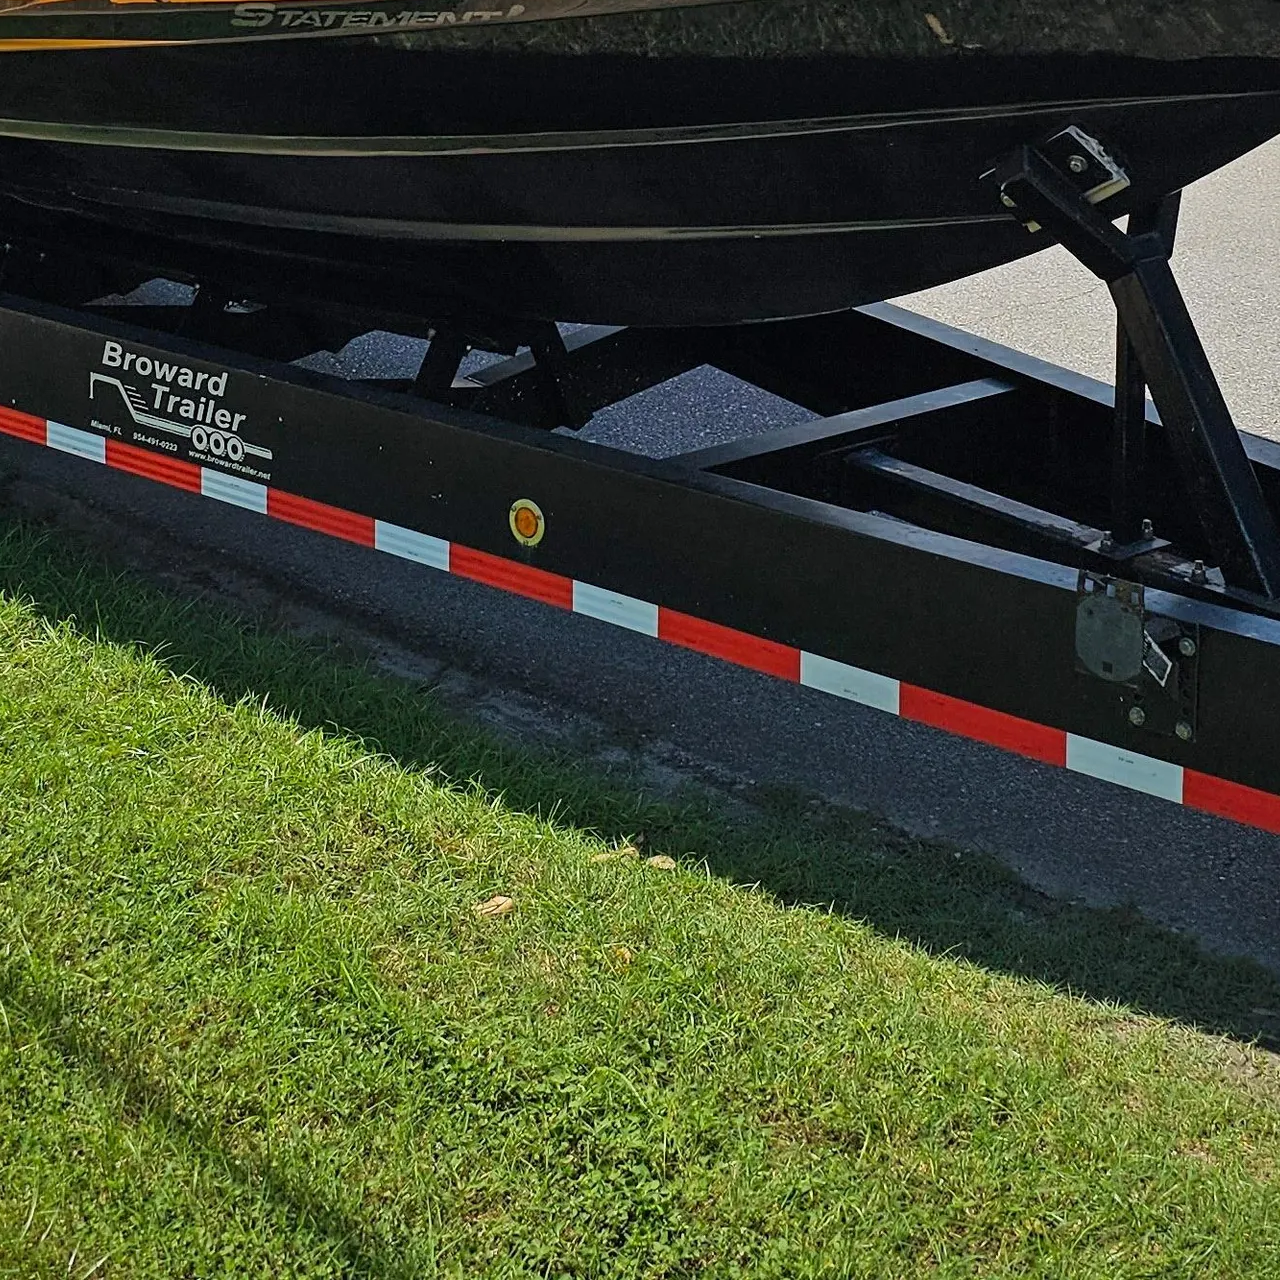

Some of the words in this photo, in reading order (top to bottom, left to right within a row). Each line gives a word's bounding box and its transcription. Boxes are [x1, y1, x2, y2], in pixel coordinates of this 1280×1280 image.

[101, 340, 229, 397] Broward
[90, 419, 112, 433] Miami,
[150, 383, 247, 432] Trailer
[188, 449, 271, 480] www.browardtrailer.net
